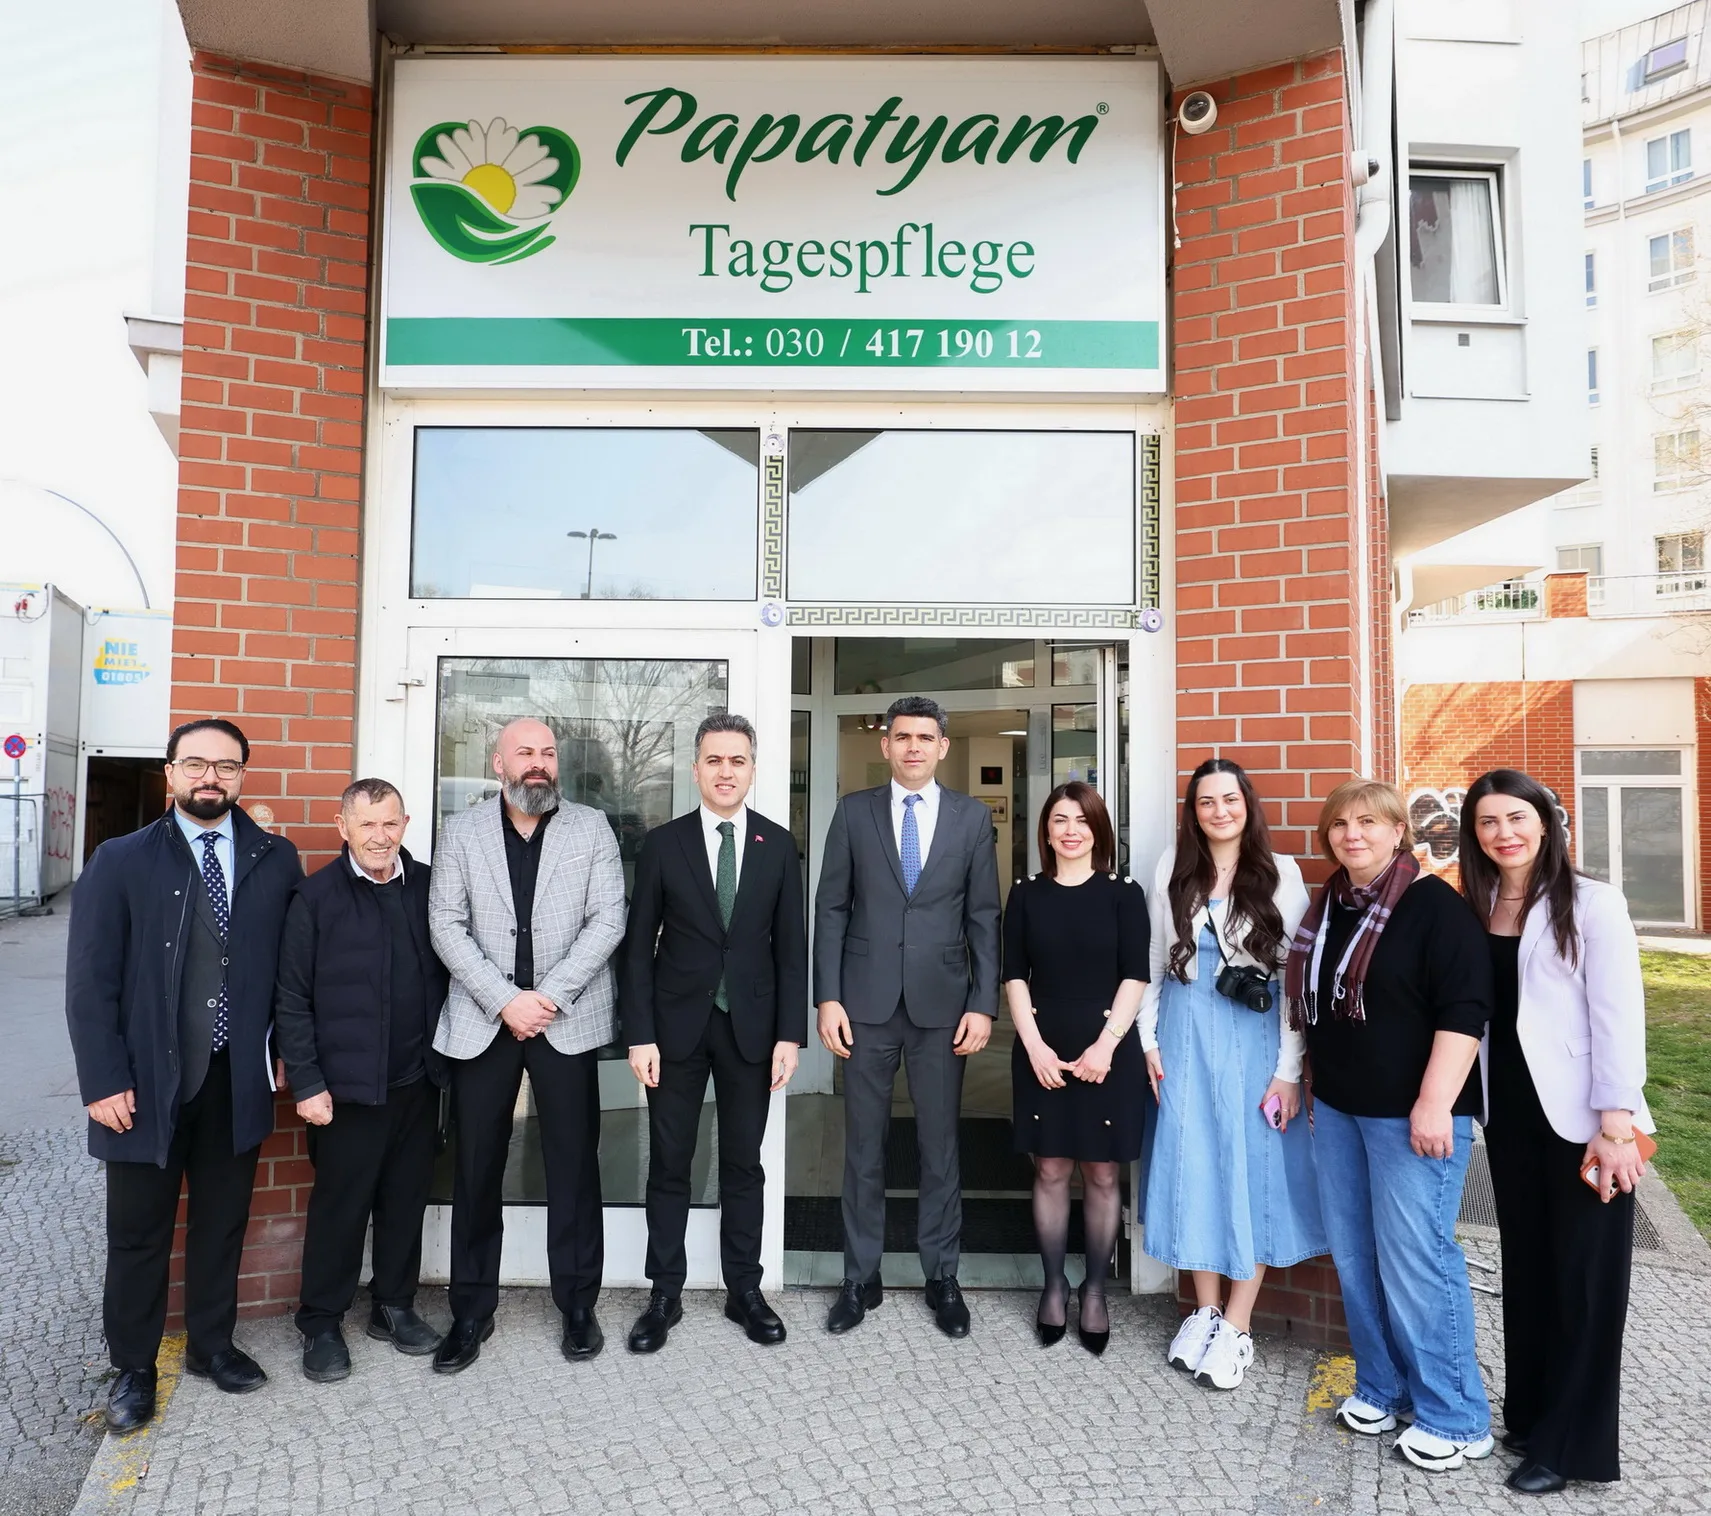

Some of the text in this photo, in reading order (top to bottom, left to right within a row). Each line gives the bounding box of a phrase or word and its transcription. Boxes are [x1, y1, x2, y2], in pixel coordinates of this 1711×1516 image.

[689, 222, 1035, 294] Tagespflege
[682, 328, 1043, 359] Tel.: 030 / 417 190 12
